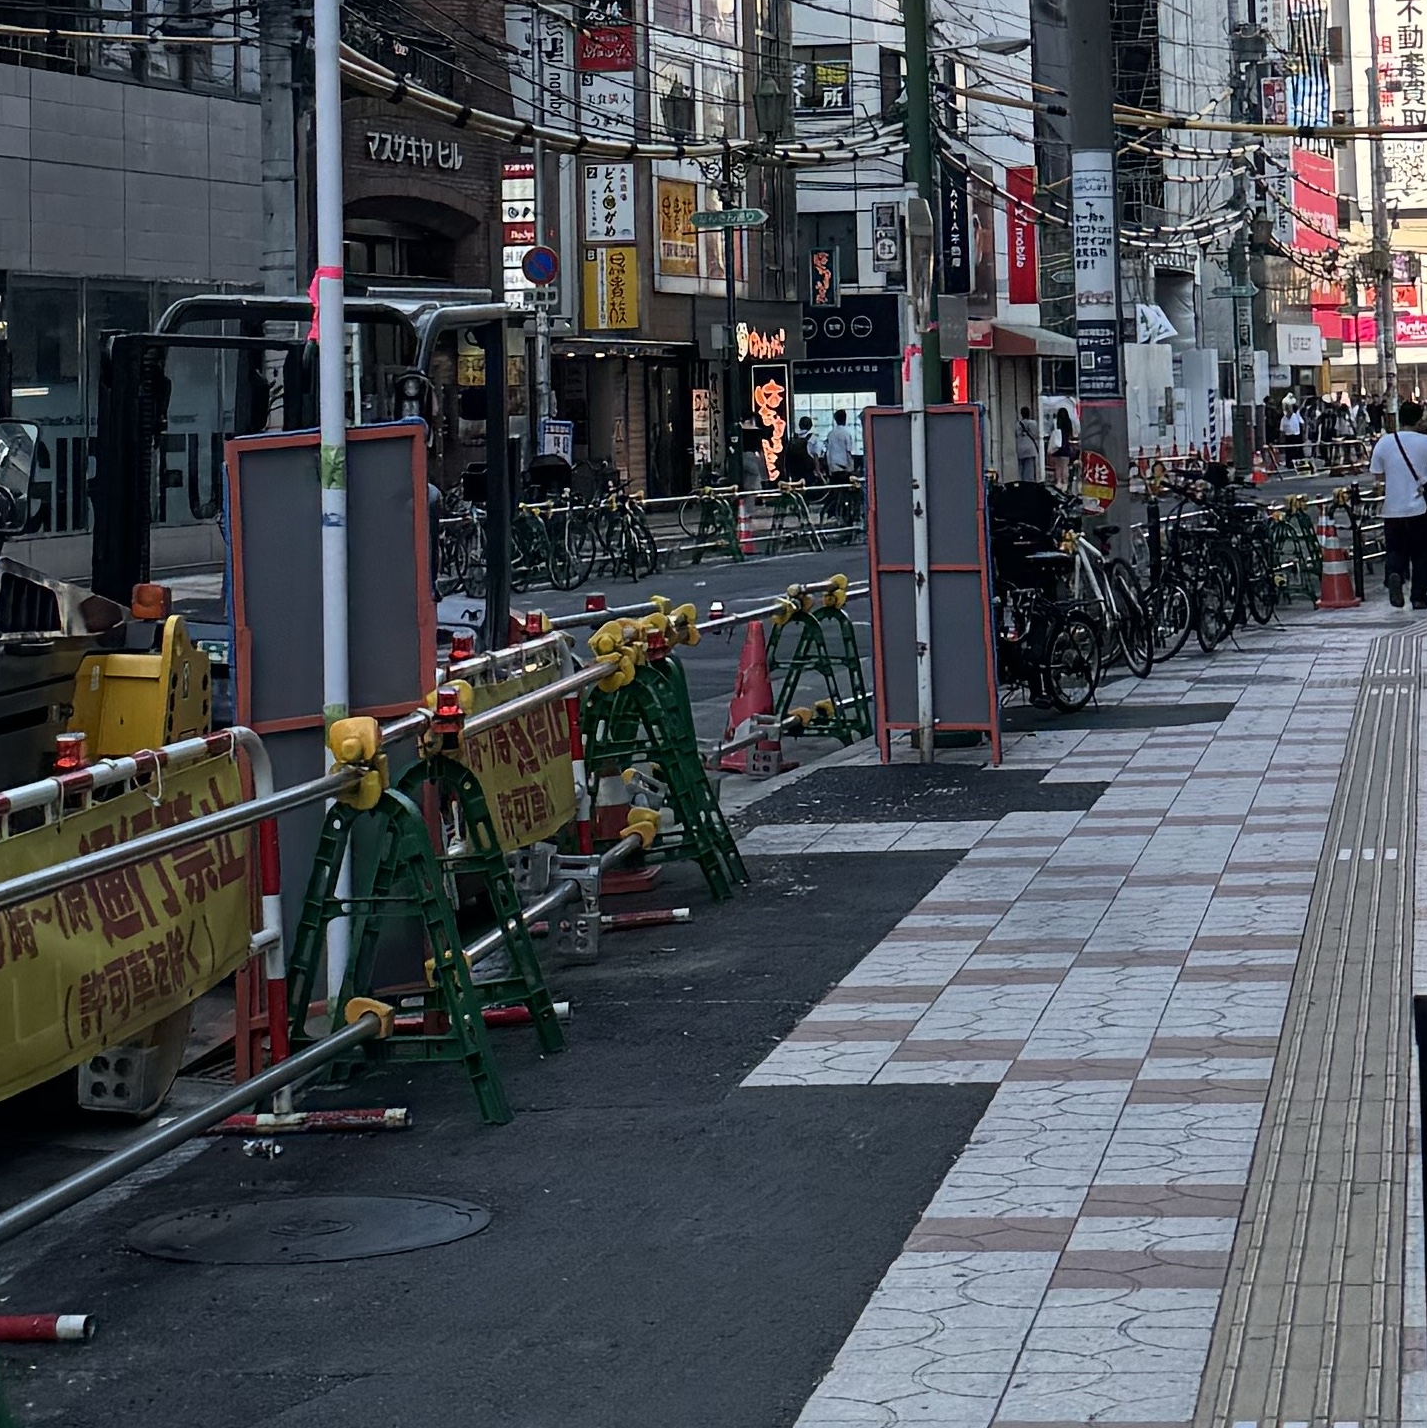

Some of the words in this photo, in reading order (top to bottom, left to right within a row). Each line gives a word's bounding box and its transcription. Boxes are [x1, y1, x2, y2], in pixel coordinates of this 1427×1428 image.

[366, 132, 433, 167] マスザキヤ
[437, 140, 463, 170] ビル
